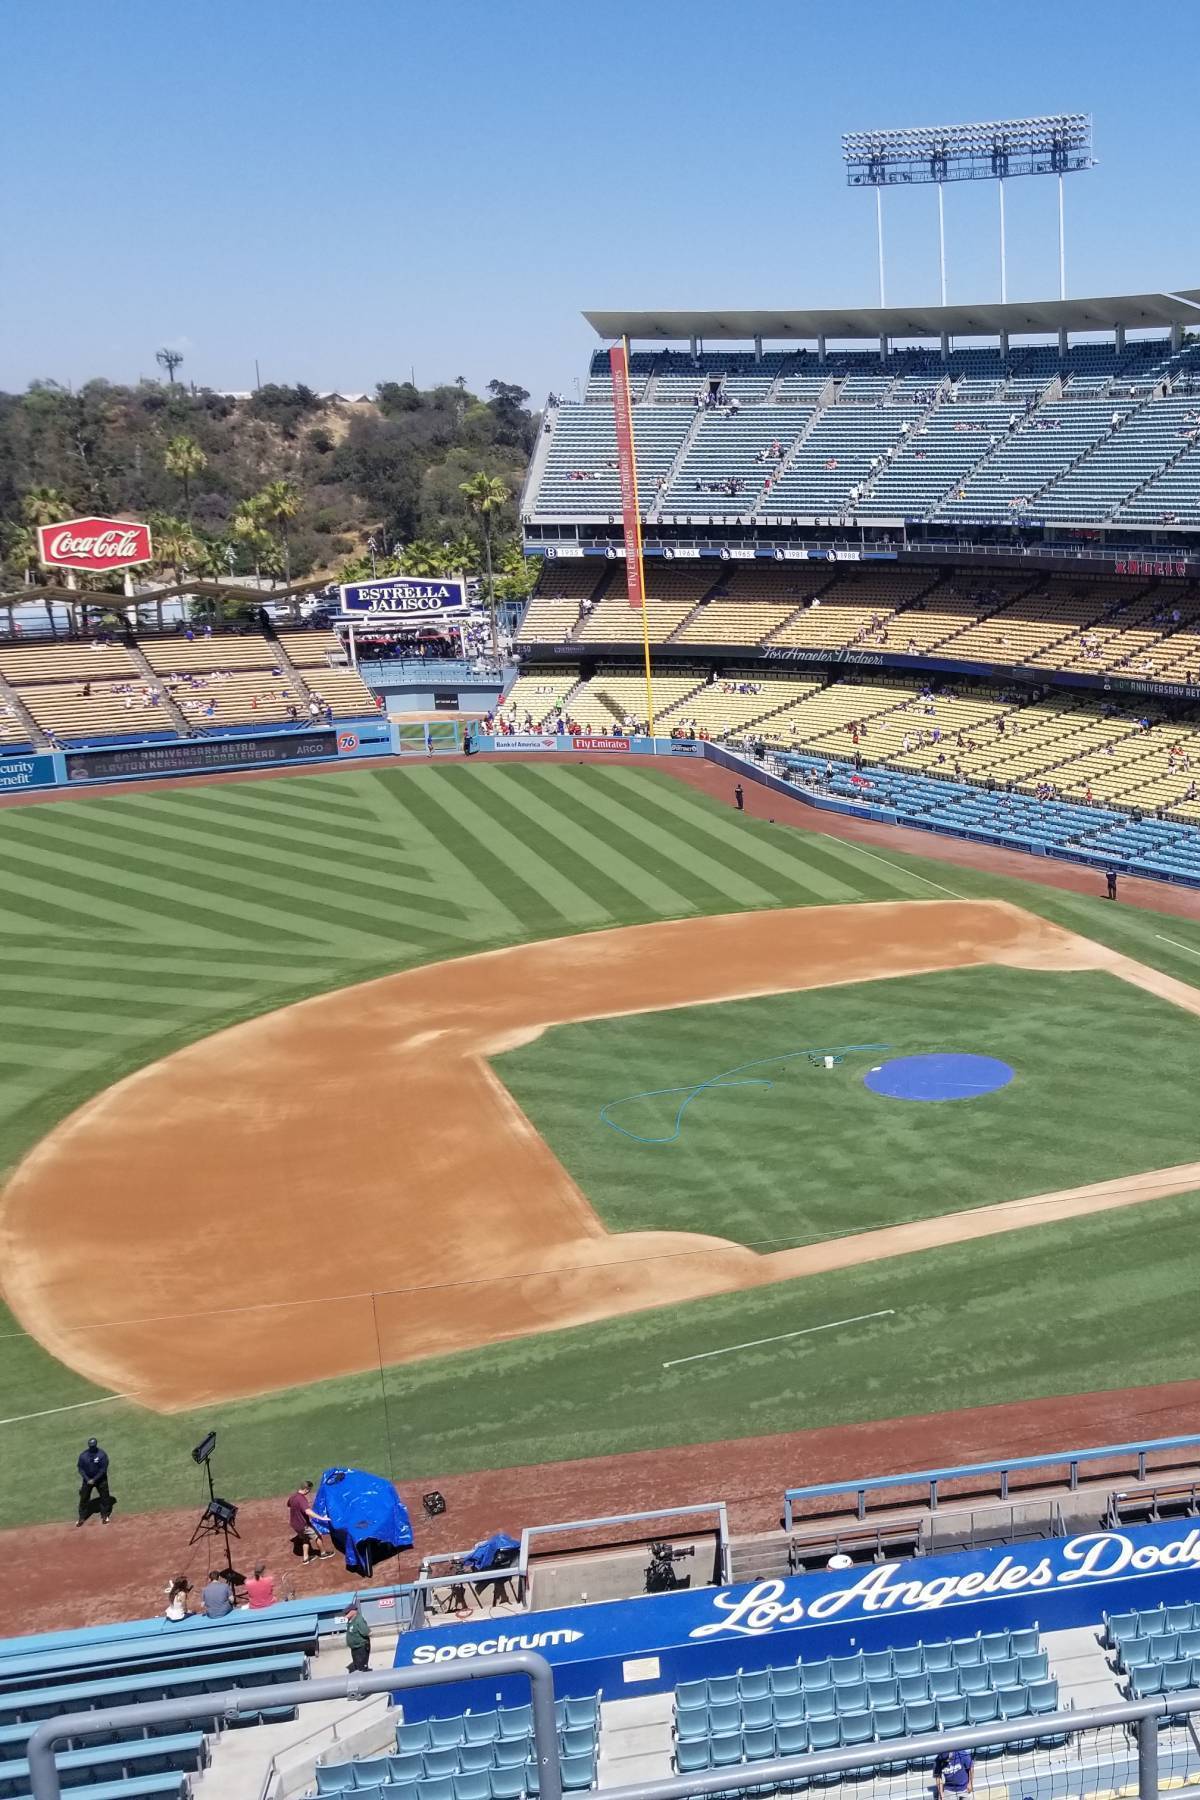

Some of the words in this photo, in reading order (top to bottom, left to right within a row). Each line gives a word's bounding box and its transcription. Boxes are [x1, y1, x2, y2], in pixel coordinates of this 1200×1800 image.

[615, 369, 628, 410] Emirates
[608, 516, 692, 526] DDGER
[708, 516, 798, 527] STADIUM
[50, 530, 141, 559] Coca-Cola
[625, 529, 637, 567] Emirates
[358, 586, 450, 601] ESTRELLA
[368, 598, 442, 612] JALISCO
[296, 744, 323, 755] ARCO
[340, 737, 355, 748] 76
[575, 739, 590, 749] Fly
[592, 739, 628, 749] Emirates
[689, 1578, 805, 1638] Los
[806, 1555, 1051, 1615] Angeles
[412, 1629, 572, 1665] Spectrum
